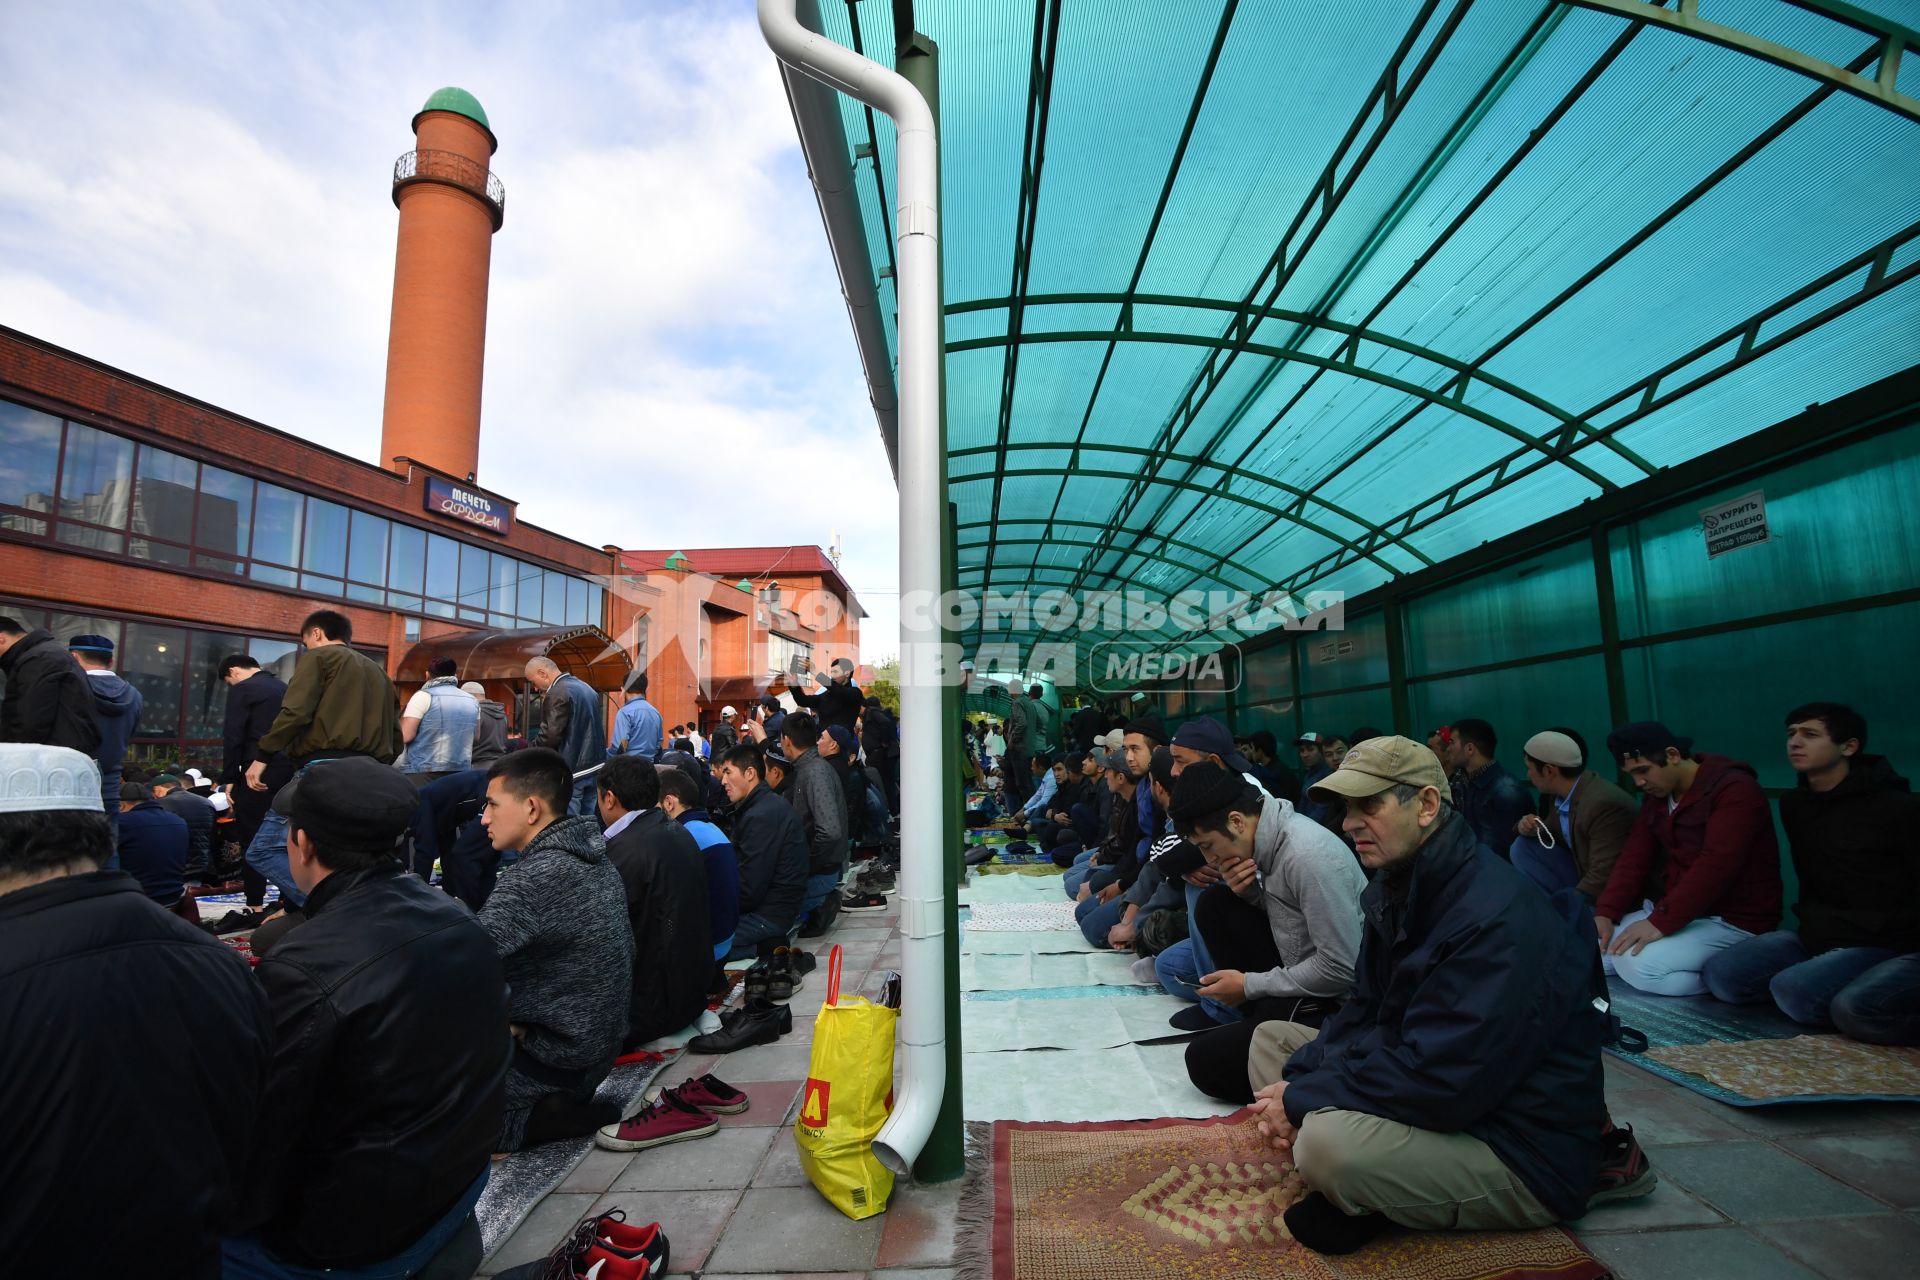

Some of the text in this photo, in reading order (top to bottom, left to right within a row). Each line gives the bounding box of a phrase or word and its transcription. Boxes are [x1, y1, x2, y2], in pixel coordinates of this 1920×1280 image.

[452, 488, 490, 511] МЕЧЕТЬ
[1719, 502, 1757, 520] КУРИТЬ
[1709, 513, 1763, 537] ЗАПРЕЩЕНО
